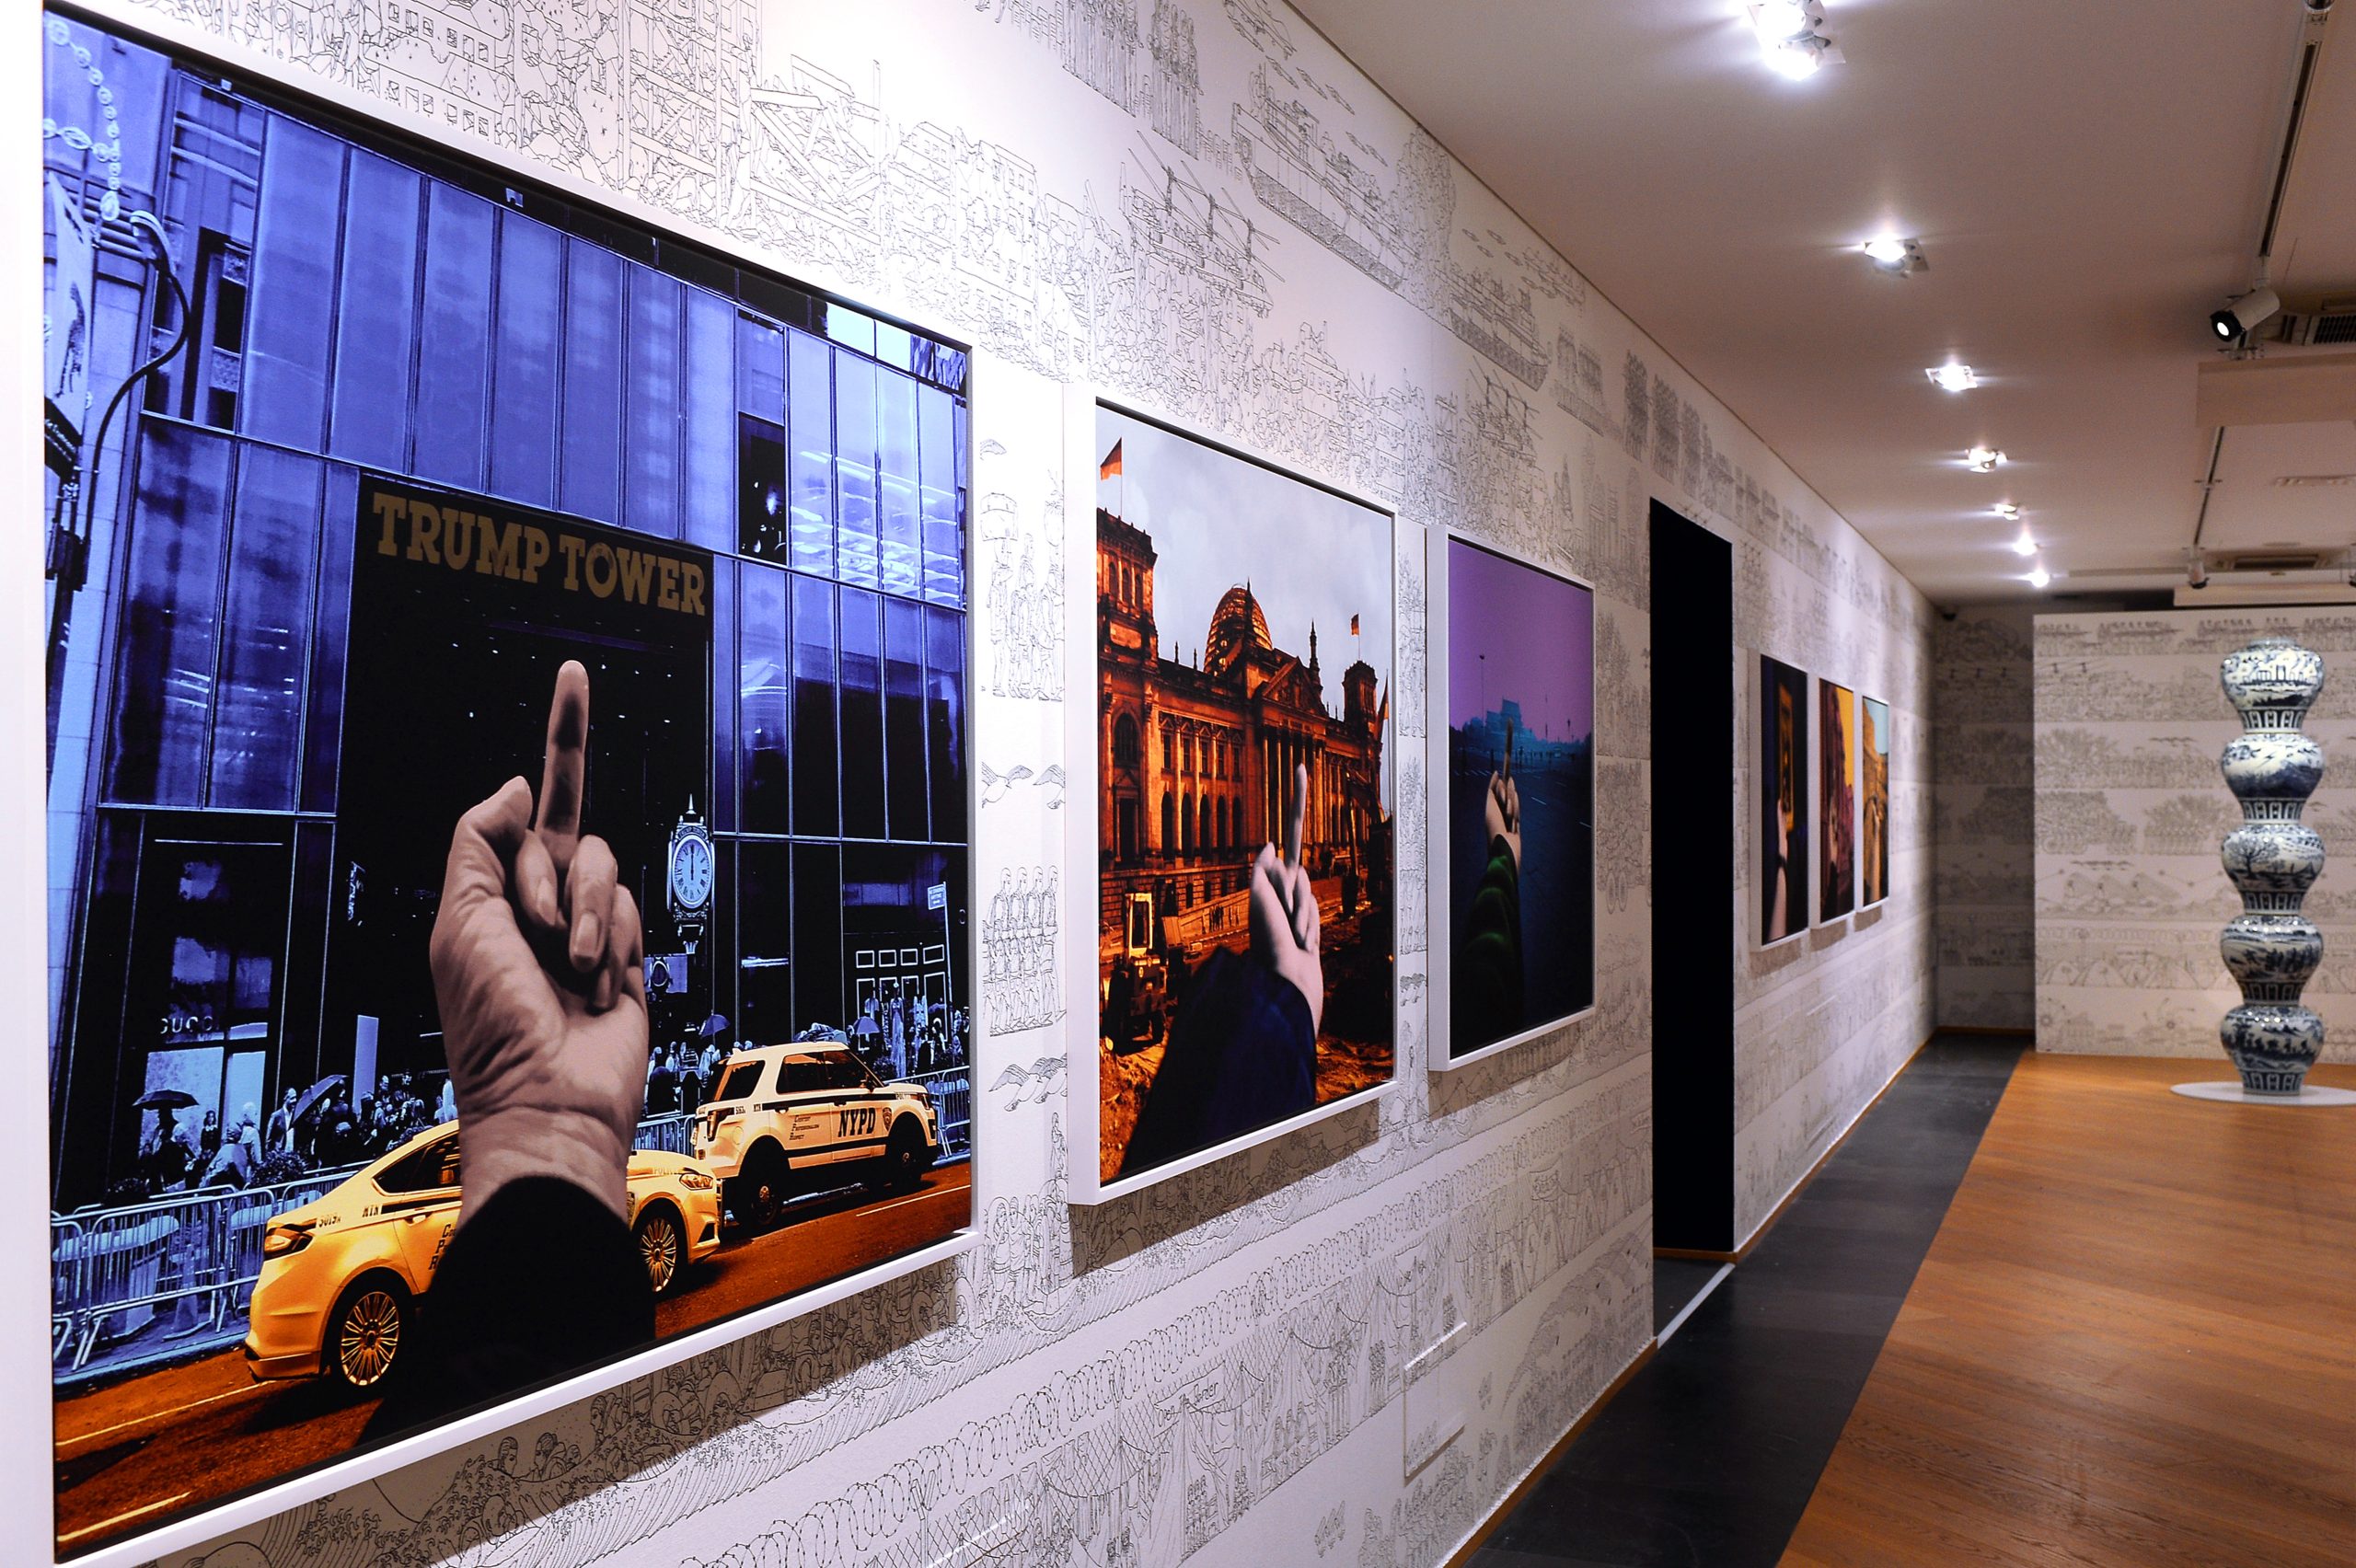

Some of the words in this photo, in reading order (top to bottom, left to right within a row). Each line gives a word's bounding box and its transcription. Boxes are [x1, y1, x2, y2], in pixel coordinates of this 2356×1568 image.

[373, 492, 551, 583] TRUMP
[559, 535, 706, 617] TOWER
[837, 1107, 877, 1138] NYPD
